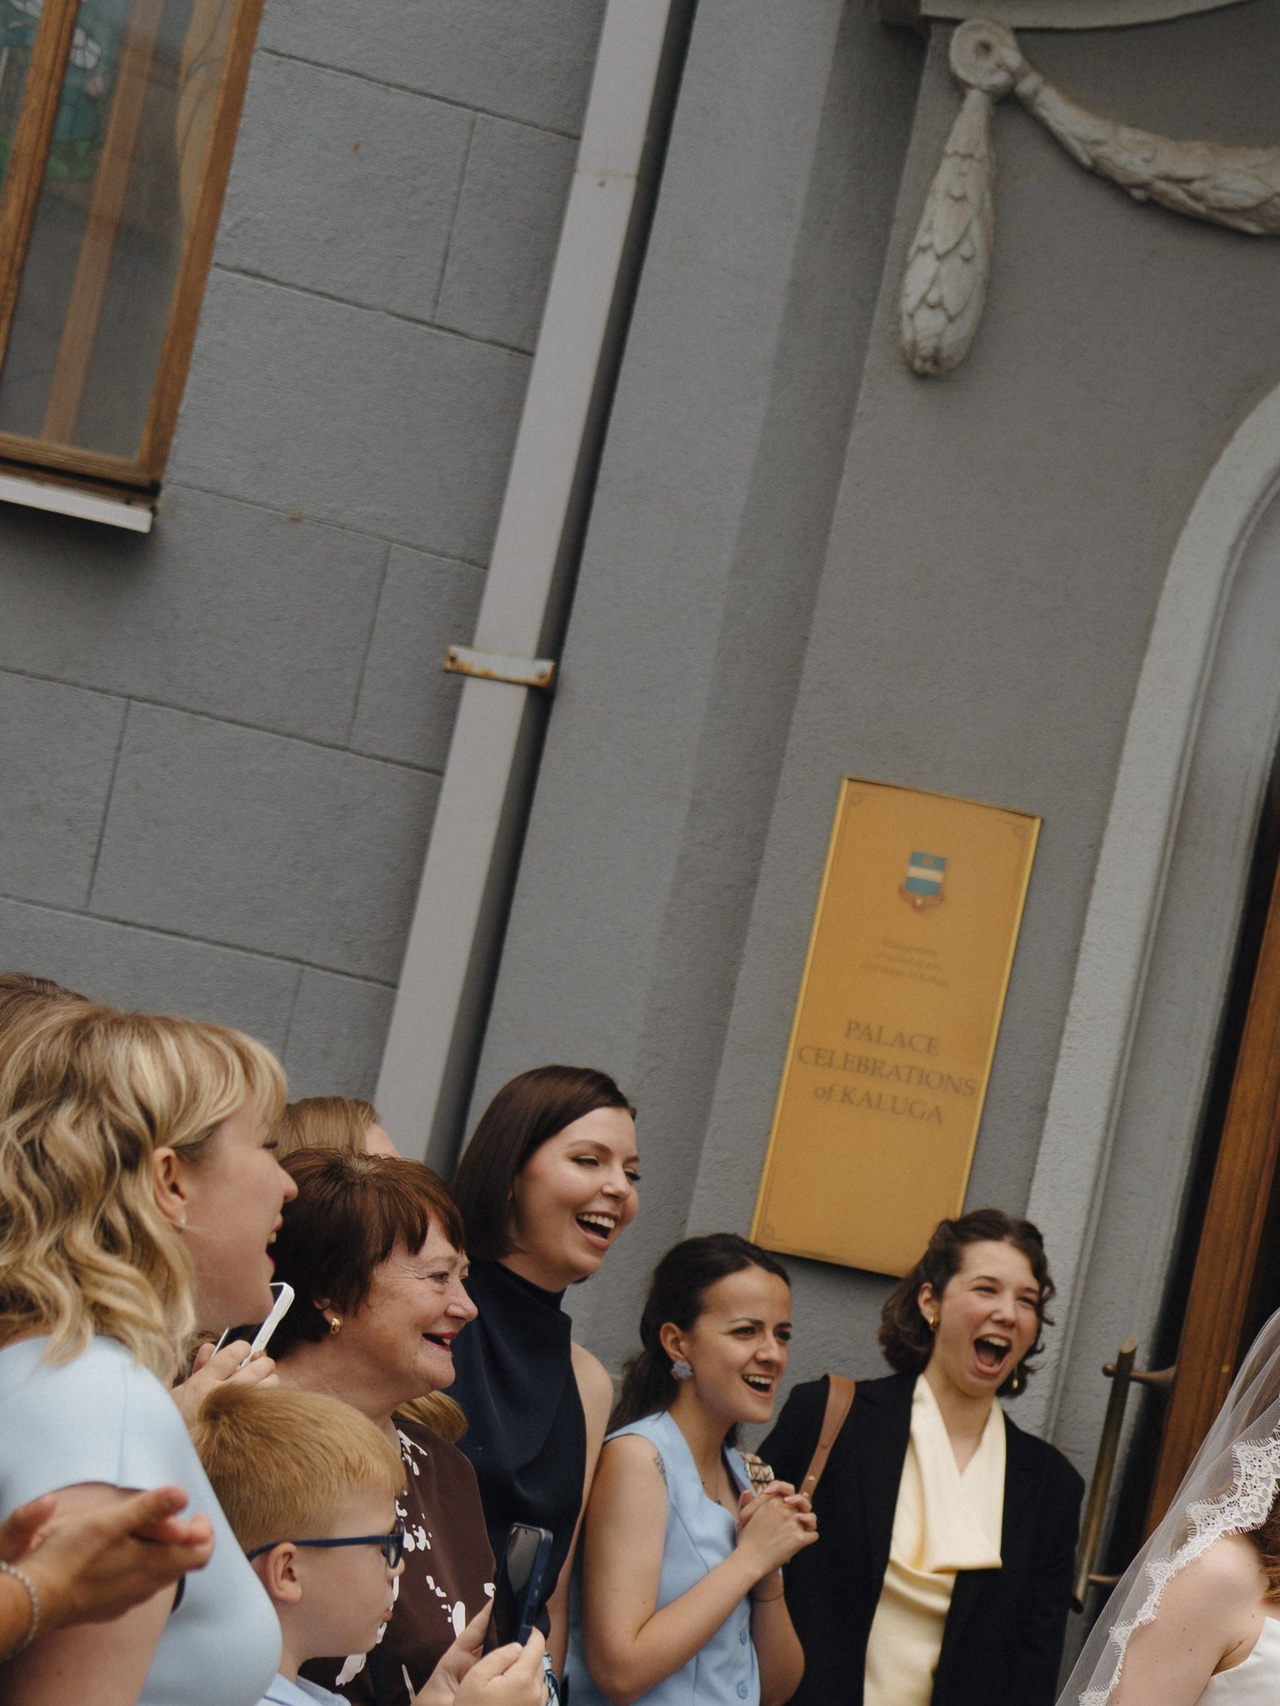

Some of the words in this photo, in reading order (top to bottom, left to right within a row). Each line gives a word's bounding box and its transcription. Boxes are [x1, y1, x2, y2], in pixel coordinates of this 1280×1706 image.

[843, 1020, 942, 1056] PALACE
[797, 1045, 977, 1098] CELEBRATIONS
[814, 1083, 838, 1102] of
[840, 1085, 943, 1125] KALUGA
